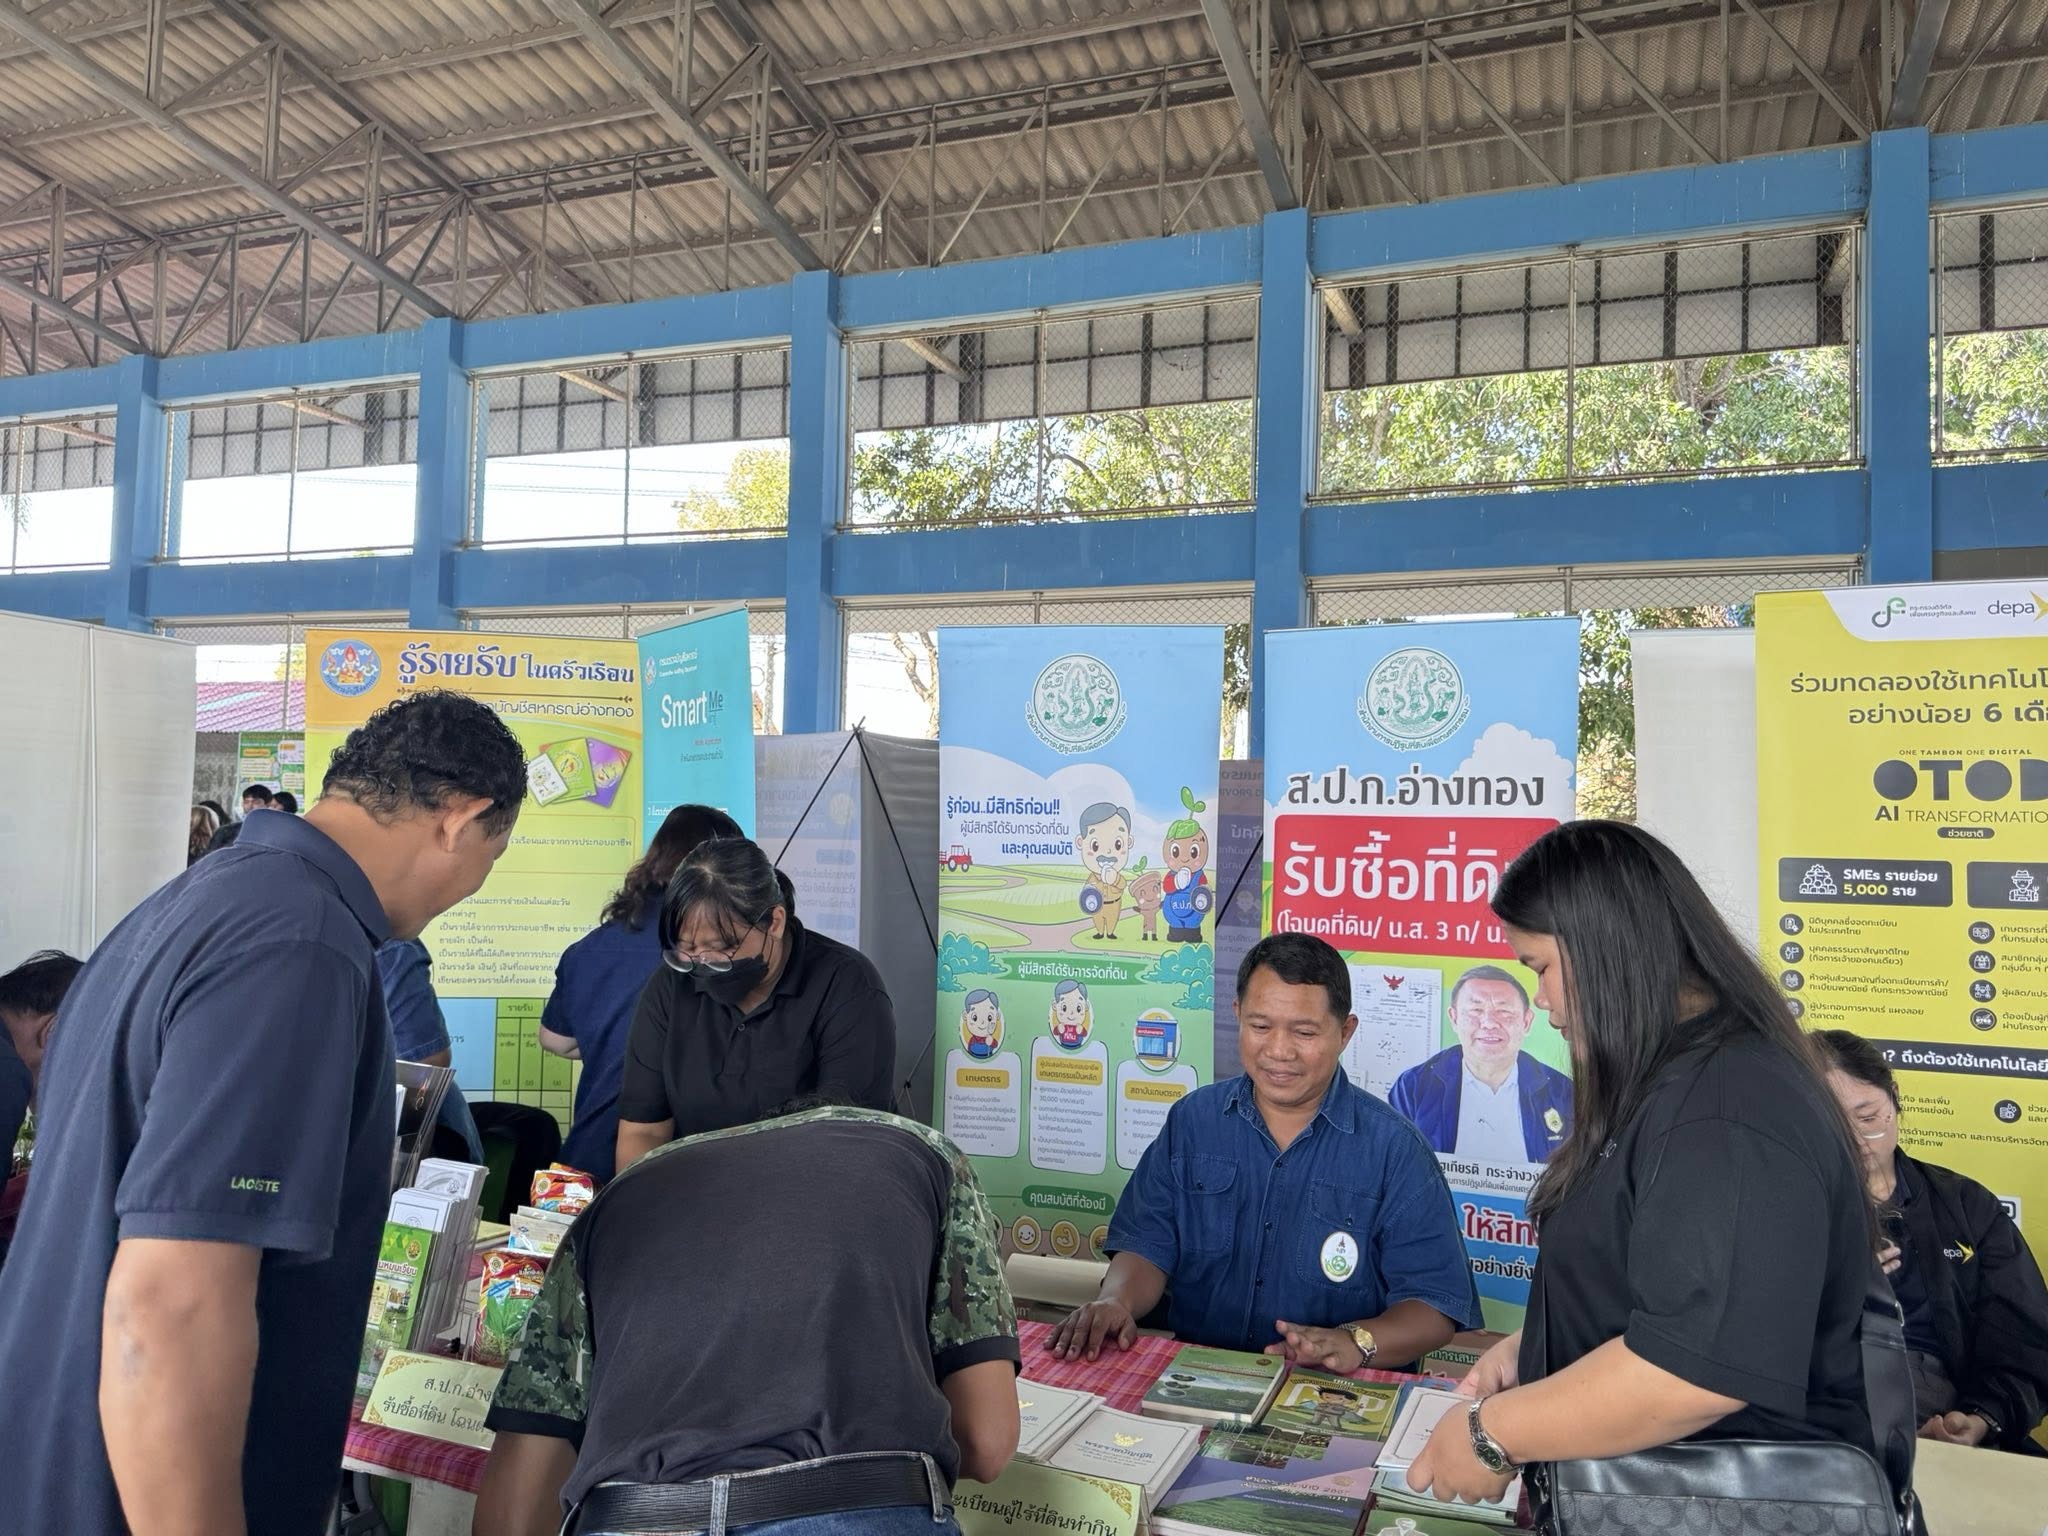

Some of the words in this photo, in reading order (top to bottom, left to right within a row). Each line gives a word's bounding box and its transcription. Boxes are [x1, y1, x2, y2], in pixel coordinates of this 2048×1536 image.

[1988, 600, 2035, 617] depa
[399, 643, 517, 683] รู้รายรับ
[525, 653, 635, 683] ในครัวเรือน
[661, 690, 707, 729] Smart
[709, 689, 723, 709] Me
[1849, 702, 1971, 724] อย่างน้อย
[1983, 703, 2002, 723] 6
[2014, 699, 2048, 722] เดื
[1288, 766, 1544, 806] ส.ป.ก.อ่างทอง
[946, 796, 1060, 819] รู้ก่อน..มีสิทธิก่อน!!
[1875, 806, 1899, 821] AI
[1905, 810, 2048, 823] TRANSFORMATIO
[960, 820, 1069, 838] ผู้มีสิทธิได้รับการจัดที่ดิน
[1948, 828, 1984, 838] ช่วยชาติ
[1001, 841, 1073, 859] และคุณสมบัติ
[1283, 831, 1512, 903] รับซื้อที่ดิ
[1843, 869, 1880, 881] SMEs
[1885, 870, 1938, 882] รายย่อย
[1843, 884, 1888, 896] 5,000
[1892, 886, 1916, 897] ราย
[1389, 921, 1428, 940] น.ส.
[1436, 921, 1448, 941] 3
[1809, 925, 1861, 936] ในประเทศไทย
[1018, 961, 1128, 980] ผู้มีสิทธิได้รับการจัดที่ดิน
[1901, 1049, 2048, 1073] ถึงต้องใช้เทคโนโลยี
[965, 1074, 1002, 1084] เกษตรกร
[1130, 1088, 1182, 1098] สถาบันเกษตรกร
[1030, 1191, 1106, 1211] คุณสมบัติที่ต้องมี
[1463, 1204, 1538, 1247] ให้สิท
[424, 1378, 491, 1402] ส.ป.ก.อ่าง
[383, 1395, 446, 1424] รับซื้อที่ดิน
